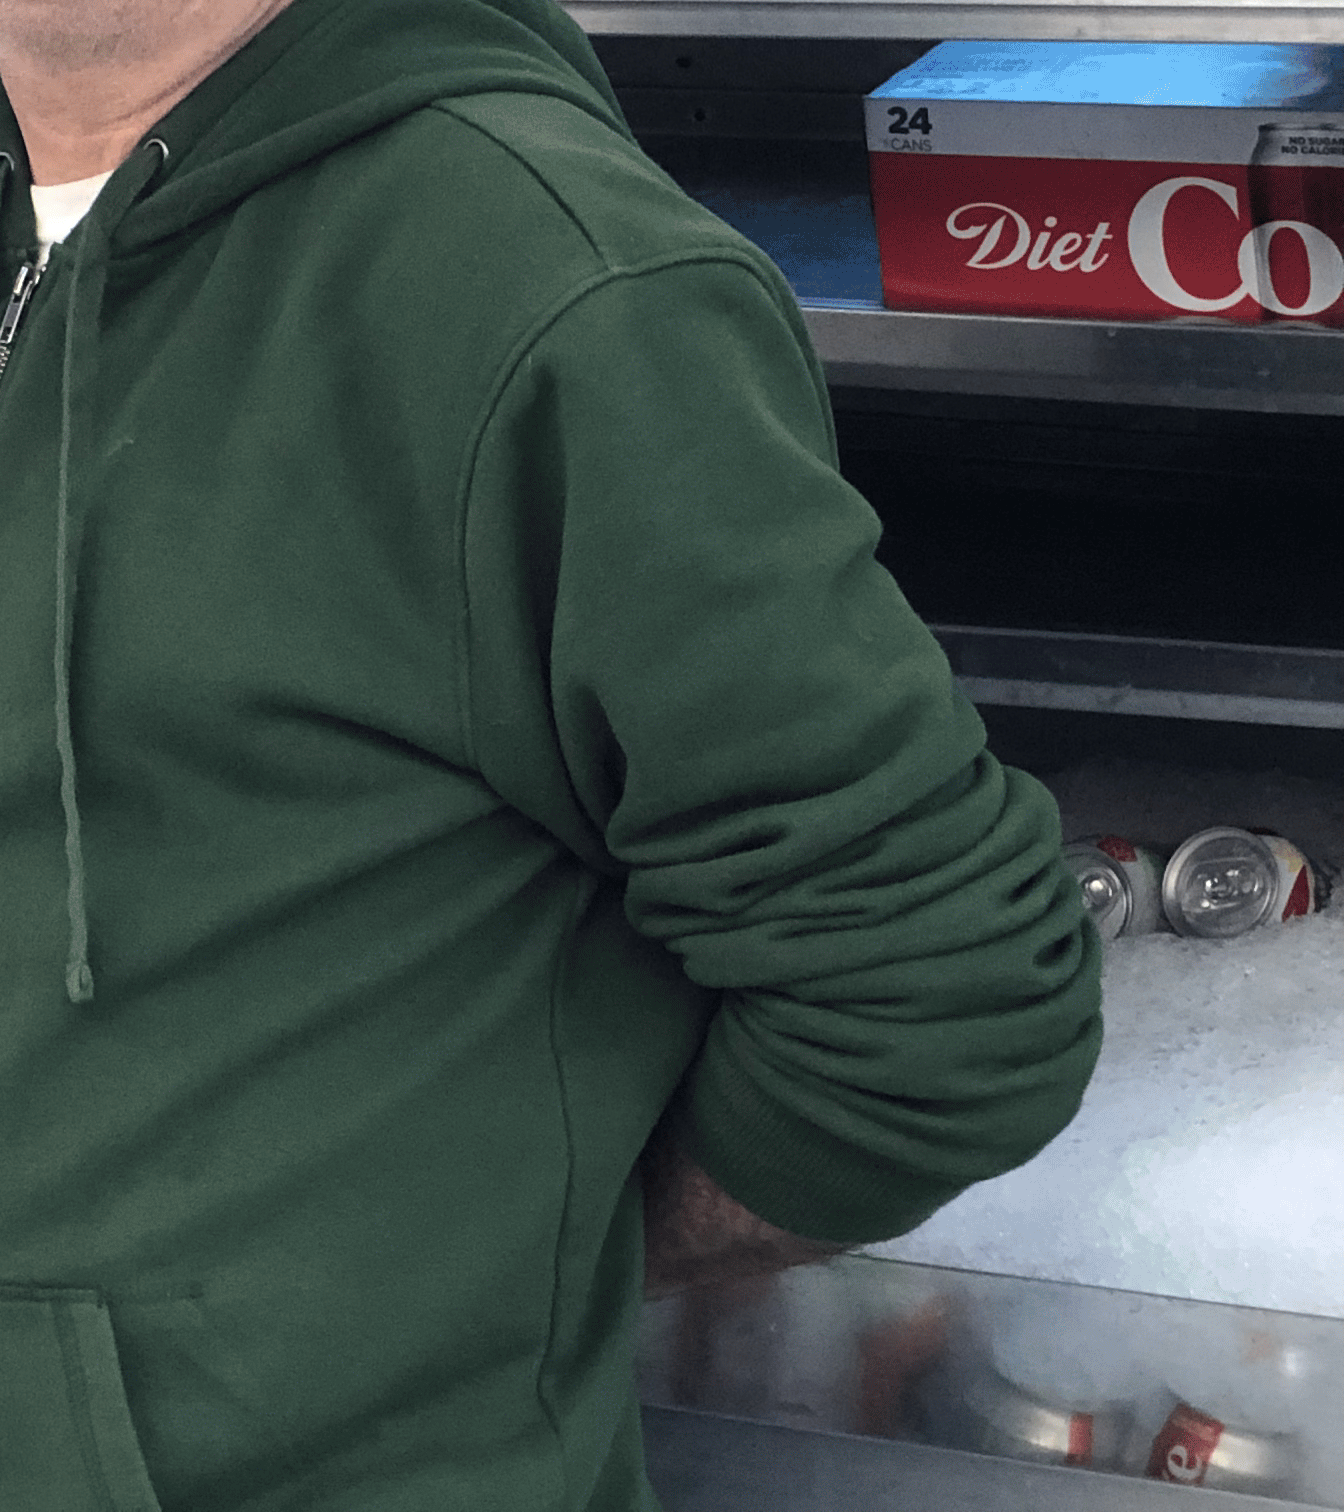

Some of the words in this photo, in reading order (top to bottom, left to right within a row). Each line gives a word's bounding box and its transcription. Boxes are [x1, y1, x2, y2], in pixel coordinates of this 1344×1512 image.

[887, 106, 933, 135] 24
[890, 137, 933, 152] CANS
[1289, 136, 1306, 145] NO
[1281, 145, 1298, 154] NO
[946, 202, 1113, 273] Diet
[1127, 176, 1344, 317] Co
